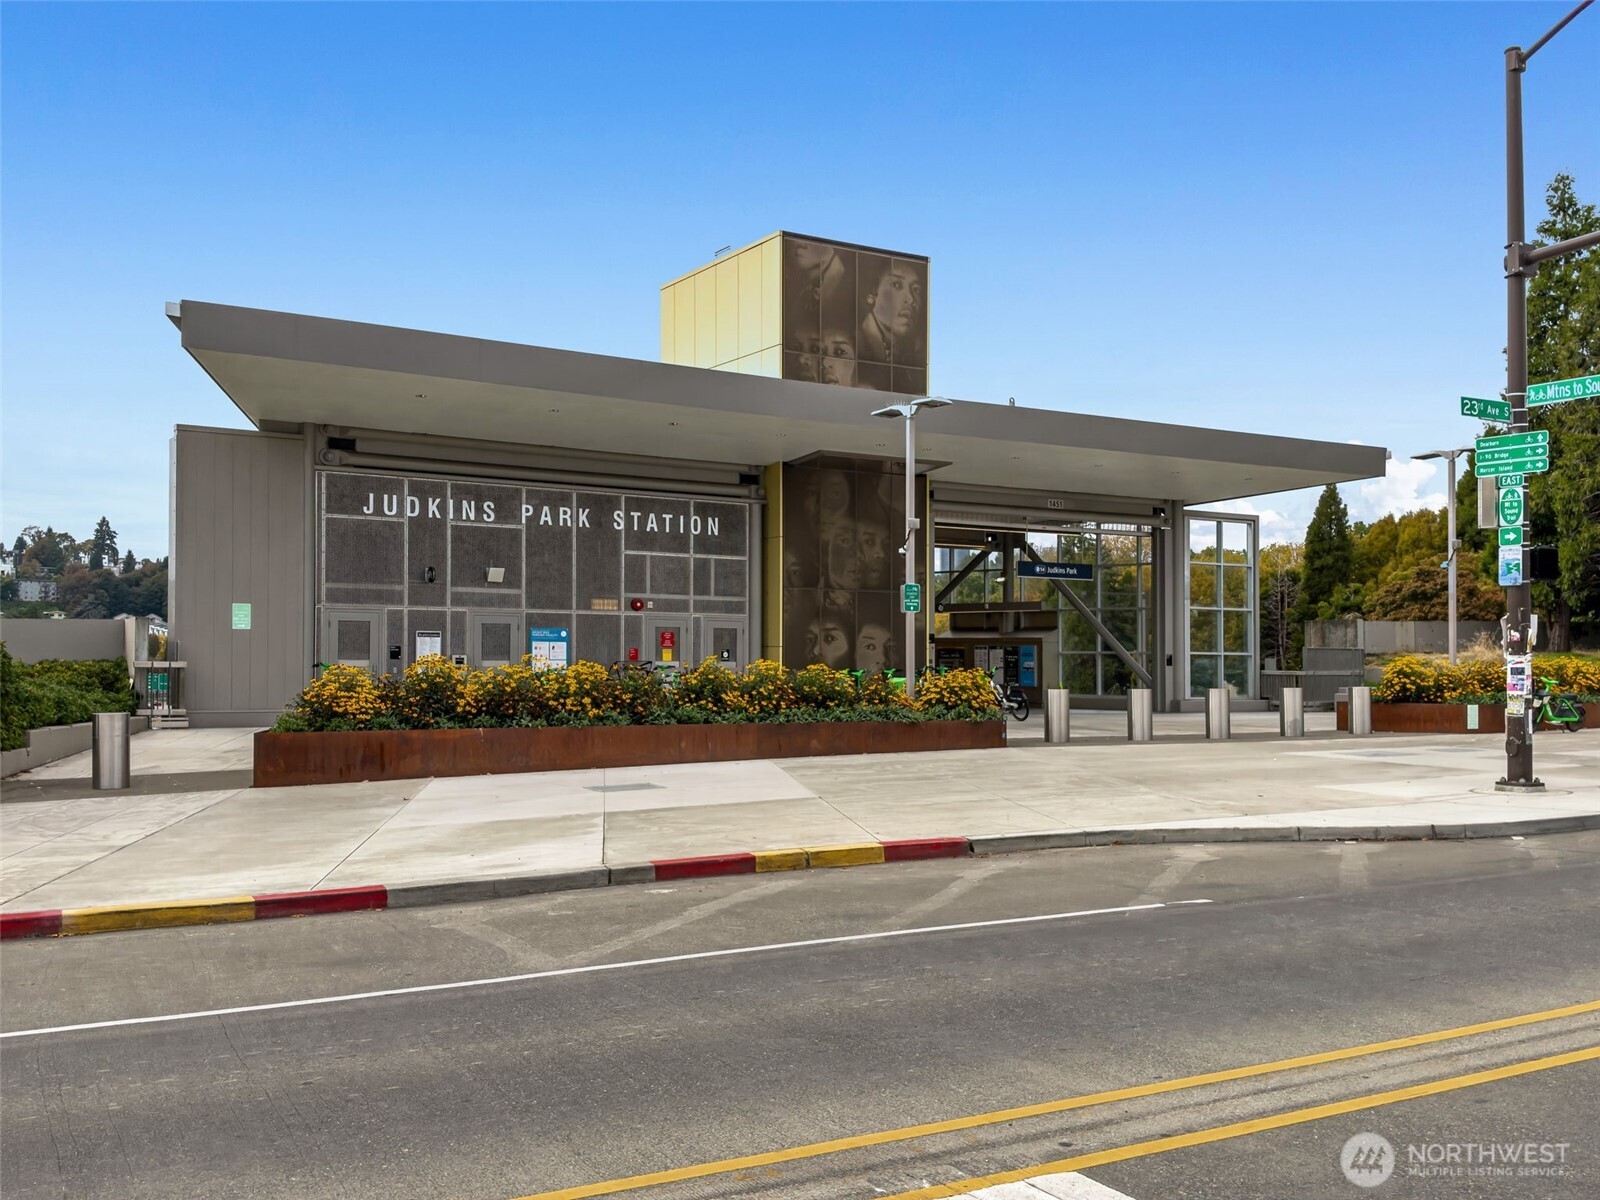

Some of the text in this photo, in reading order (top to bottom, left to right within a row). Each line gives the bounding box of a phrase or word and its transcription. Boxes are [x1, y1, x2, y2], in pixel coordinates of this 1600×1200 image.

[1547, 384, 1571, 400] Mtns
[1574, 383, 1583, 395] to
[1487, 405, 1500, 416] Ave
[1504, 407, 1509, 416] S
[1503, 476, 1520, 485] EAST
[1049, 500, 1062, 508] 1451
[363, 493, 719, 536] JUDKINS PARK STATION
[1067, 567, 1078, 575] Park
